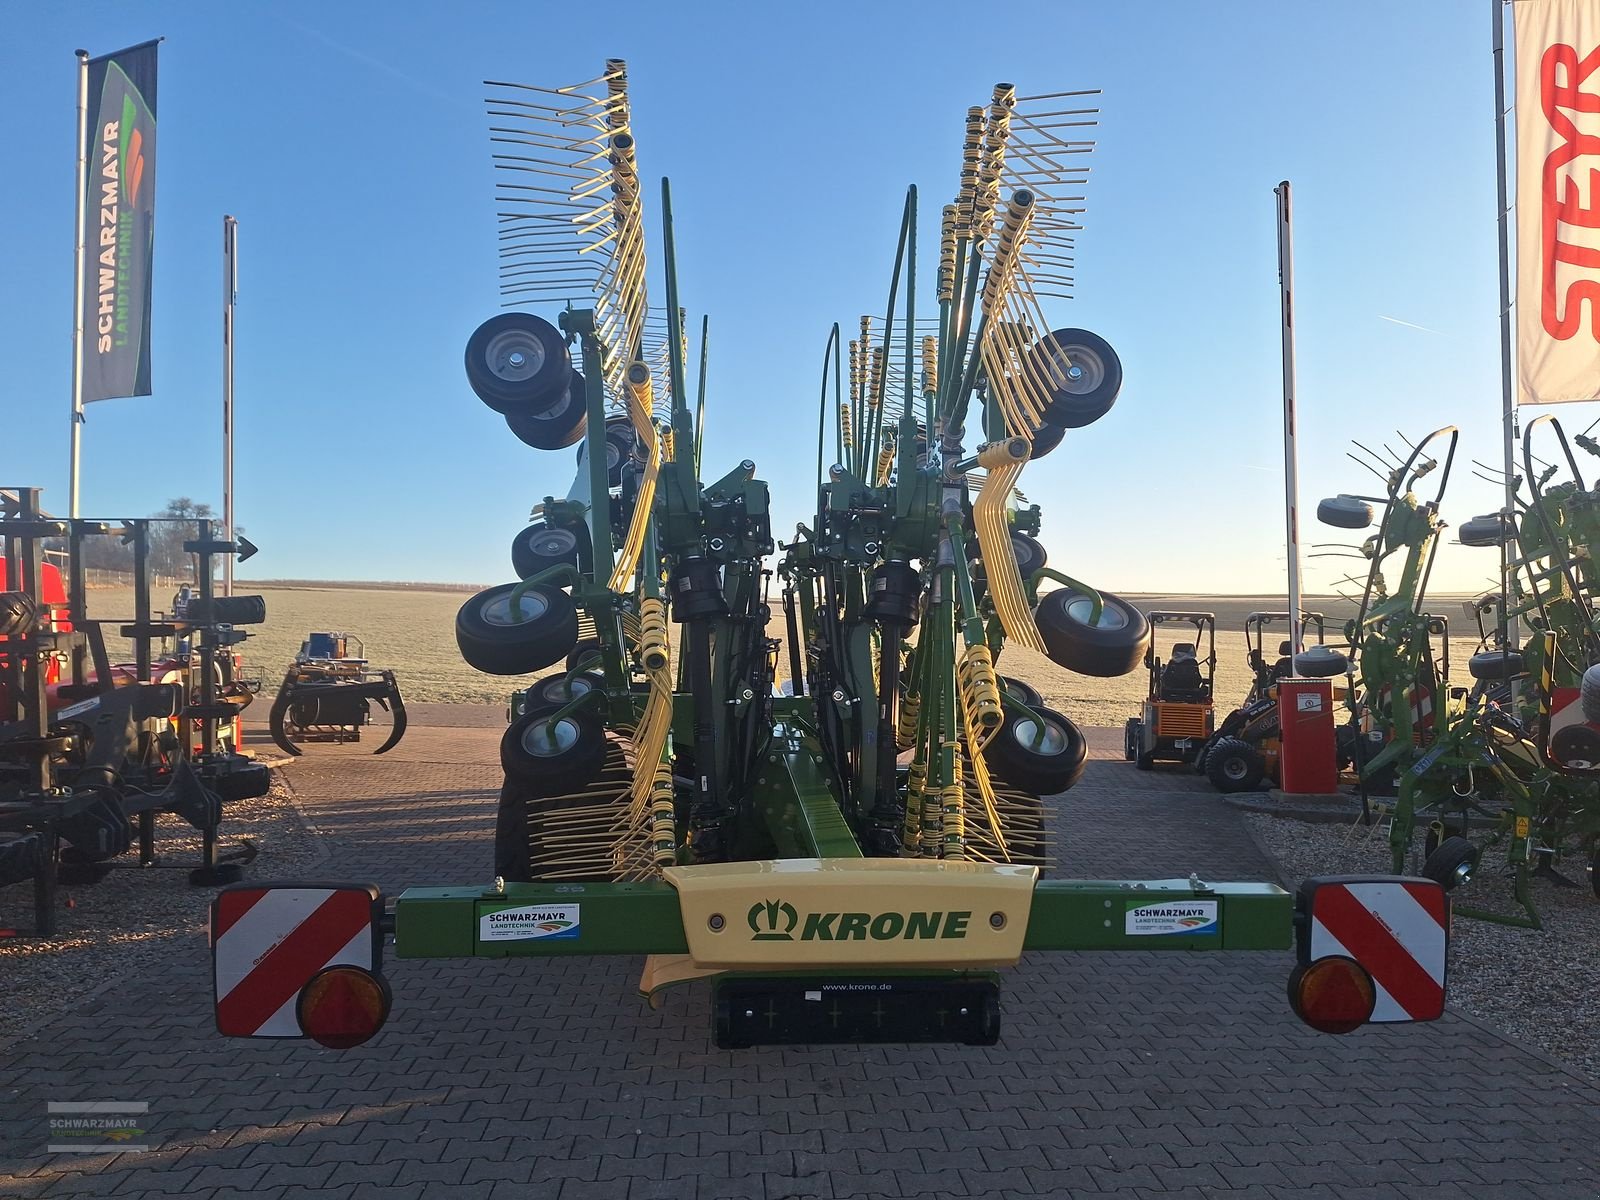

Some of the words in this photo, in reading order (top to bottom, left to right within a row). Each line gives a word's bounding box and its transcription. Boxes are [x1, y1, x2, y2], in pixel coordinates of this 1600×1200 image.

[98, 120, 120, 354] SCHWARZMAYR
[116, 210, 134, 347] LANDTECHNIK
[489, 912, 566, 922] SCHWARZMAYR
[1134, 909, 1204, 917] SCHWARZMAYR
[800, 911, 972, 941] KRONE
[822, 983, 892, 991] www.krone.de
